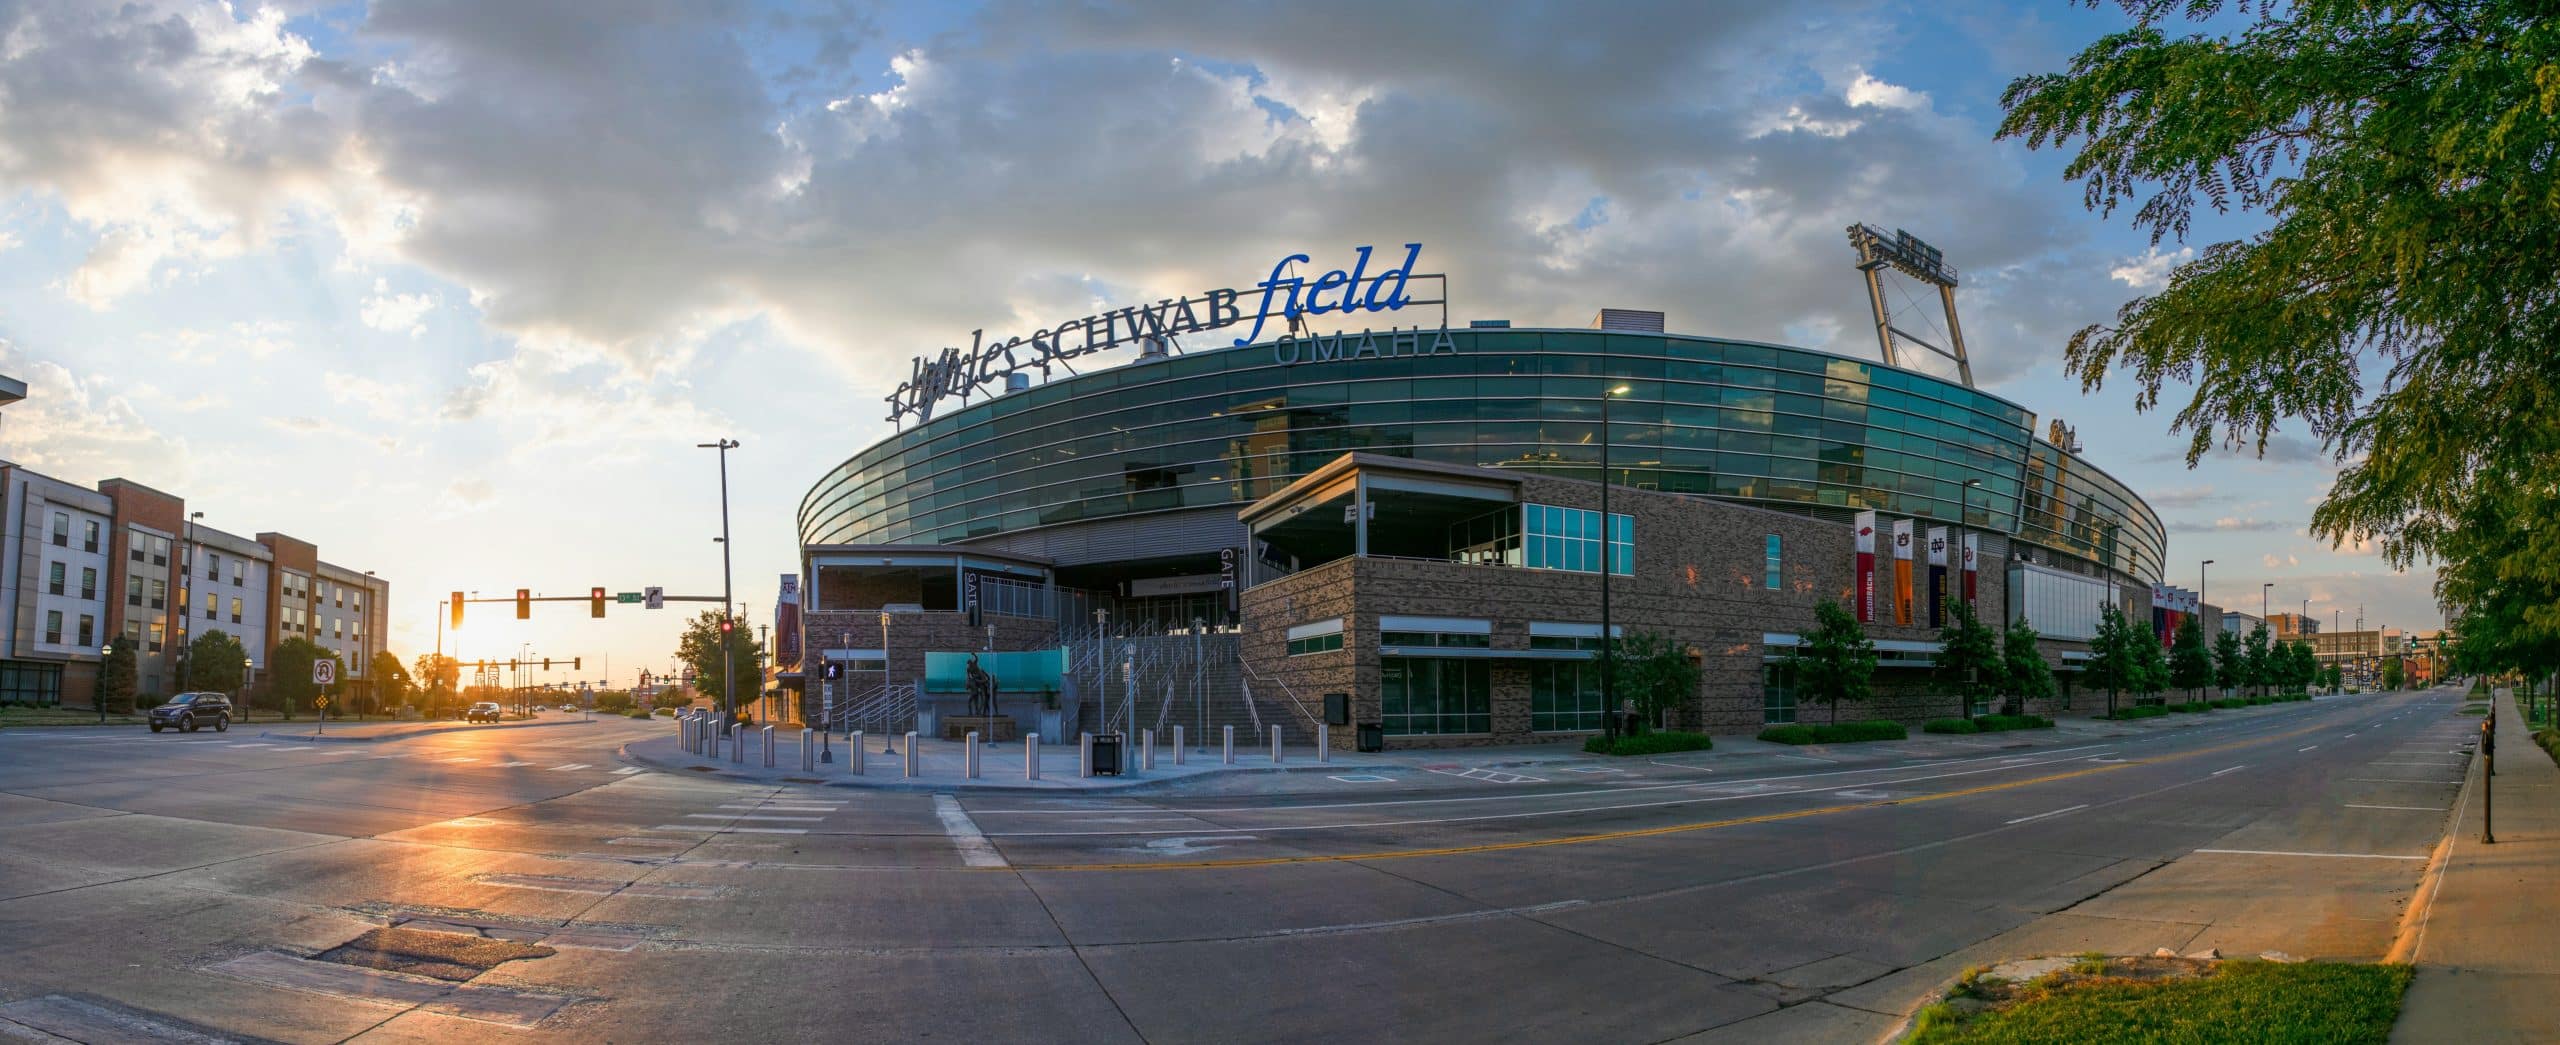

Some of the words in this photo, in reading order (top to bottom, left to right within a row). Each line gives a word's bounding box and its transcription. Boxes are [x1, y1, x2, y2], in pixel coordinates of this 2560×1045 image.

[1031, 288, 1240, 367] SCHWAB
[1234, 243, 1422, 346] field
[1274, 324, 1457, 366] OMAHA
[1221, 549, 1233, 588] GATE
[968, 573, 976, 607] GATE
